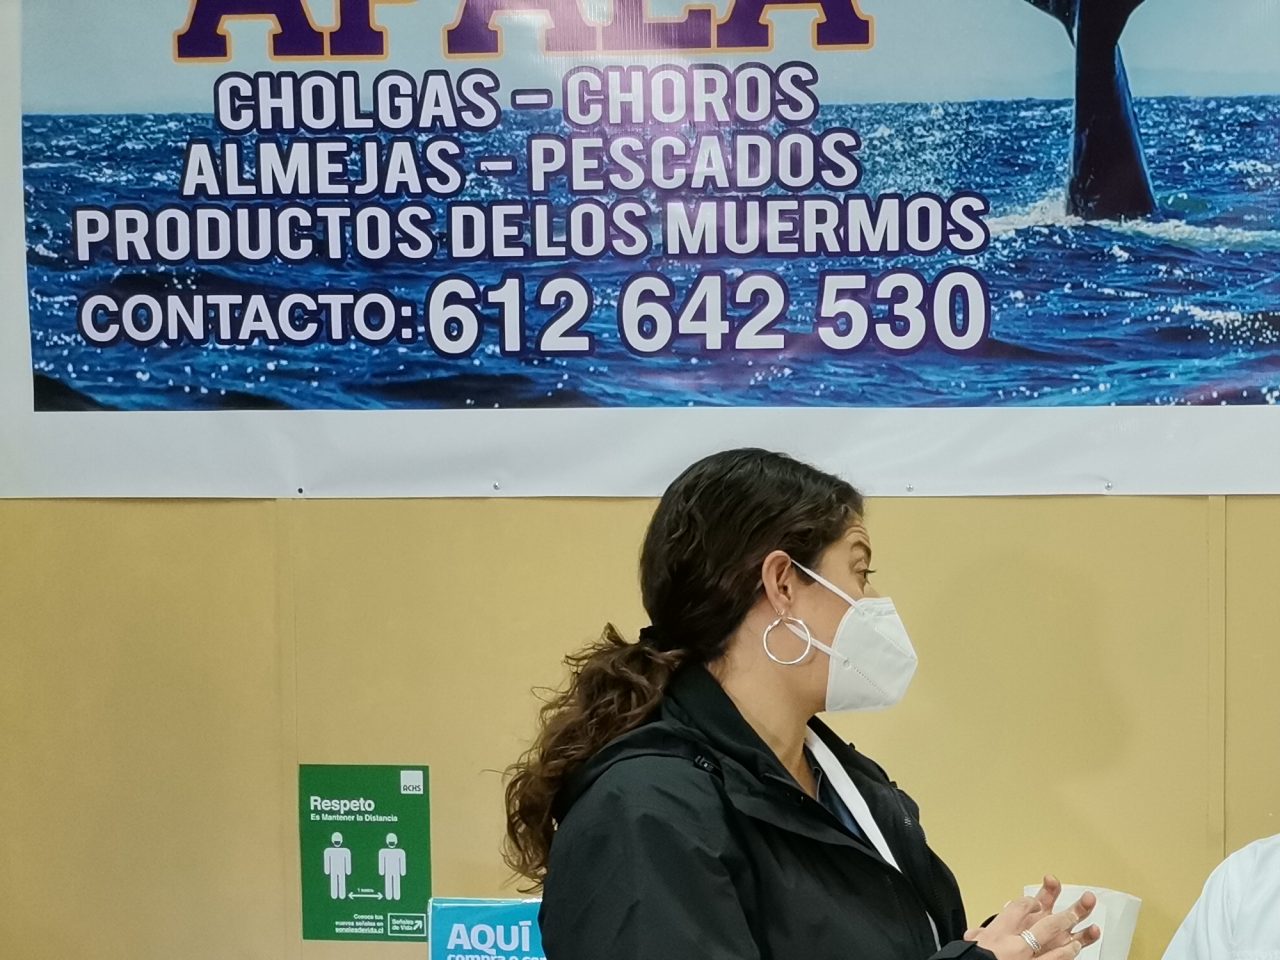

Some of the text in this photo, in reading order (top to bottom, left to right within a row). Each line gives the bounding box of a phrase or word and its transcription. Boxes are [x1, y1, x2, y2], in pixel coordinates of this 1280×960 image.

[216, 70, 498, 131] CHOLGAS
[566, 62, 817, 125] CHOROS
[182, 139, 464, 197] ALMEJAS
[531, 130, 859, 191] PESCADOS
[75, 195, 988, 262] PRODUCTOS DE LOS MUERMOS
[80, 271, 987, 354] CONTACTO: 612 642 530
[310, 796, 375, 814] Respeto
[446, 921, 532, 955] AQUÍ
